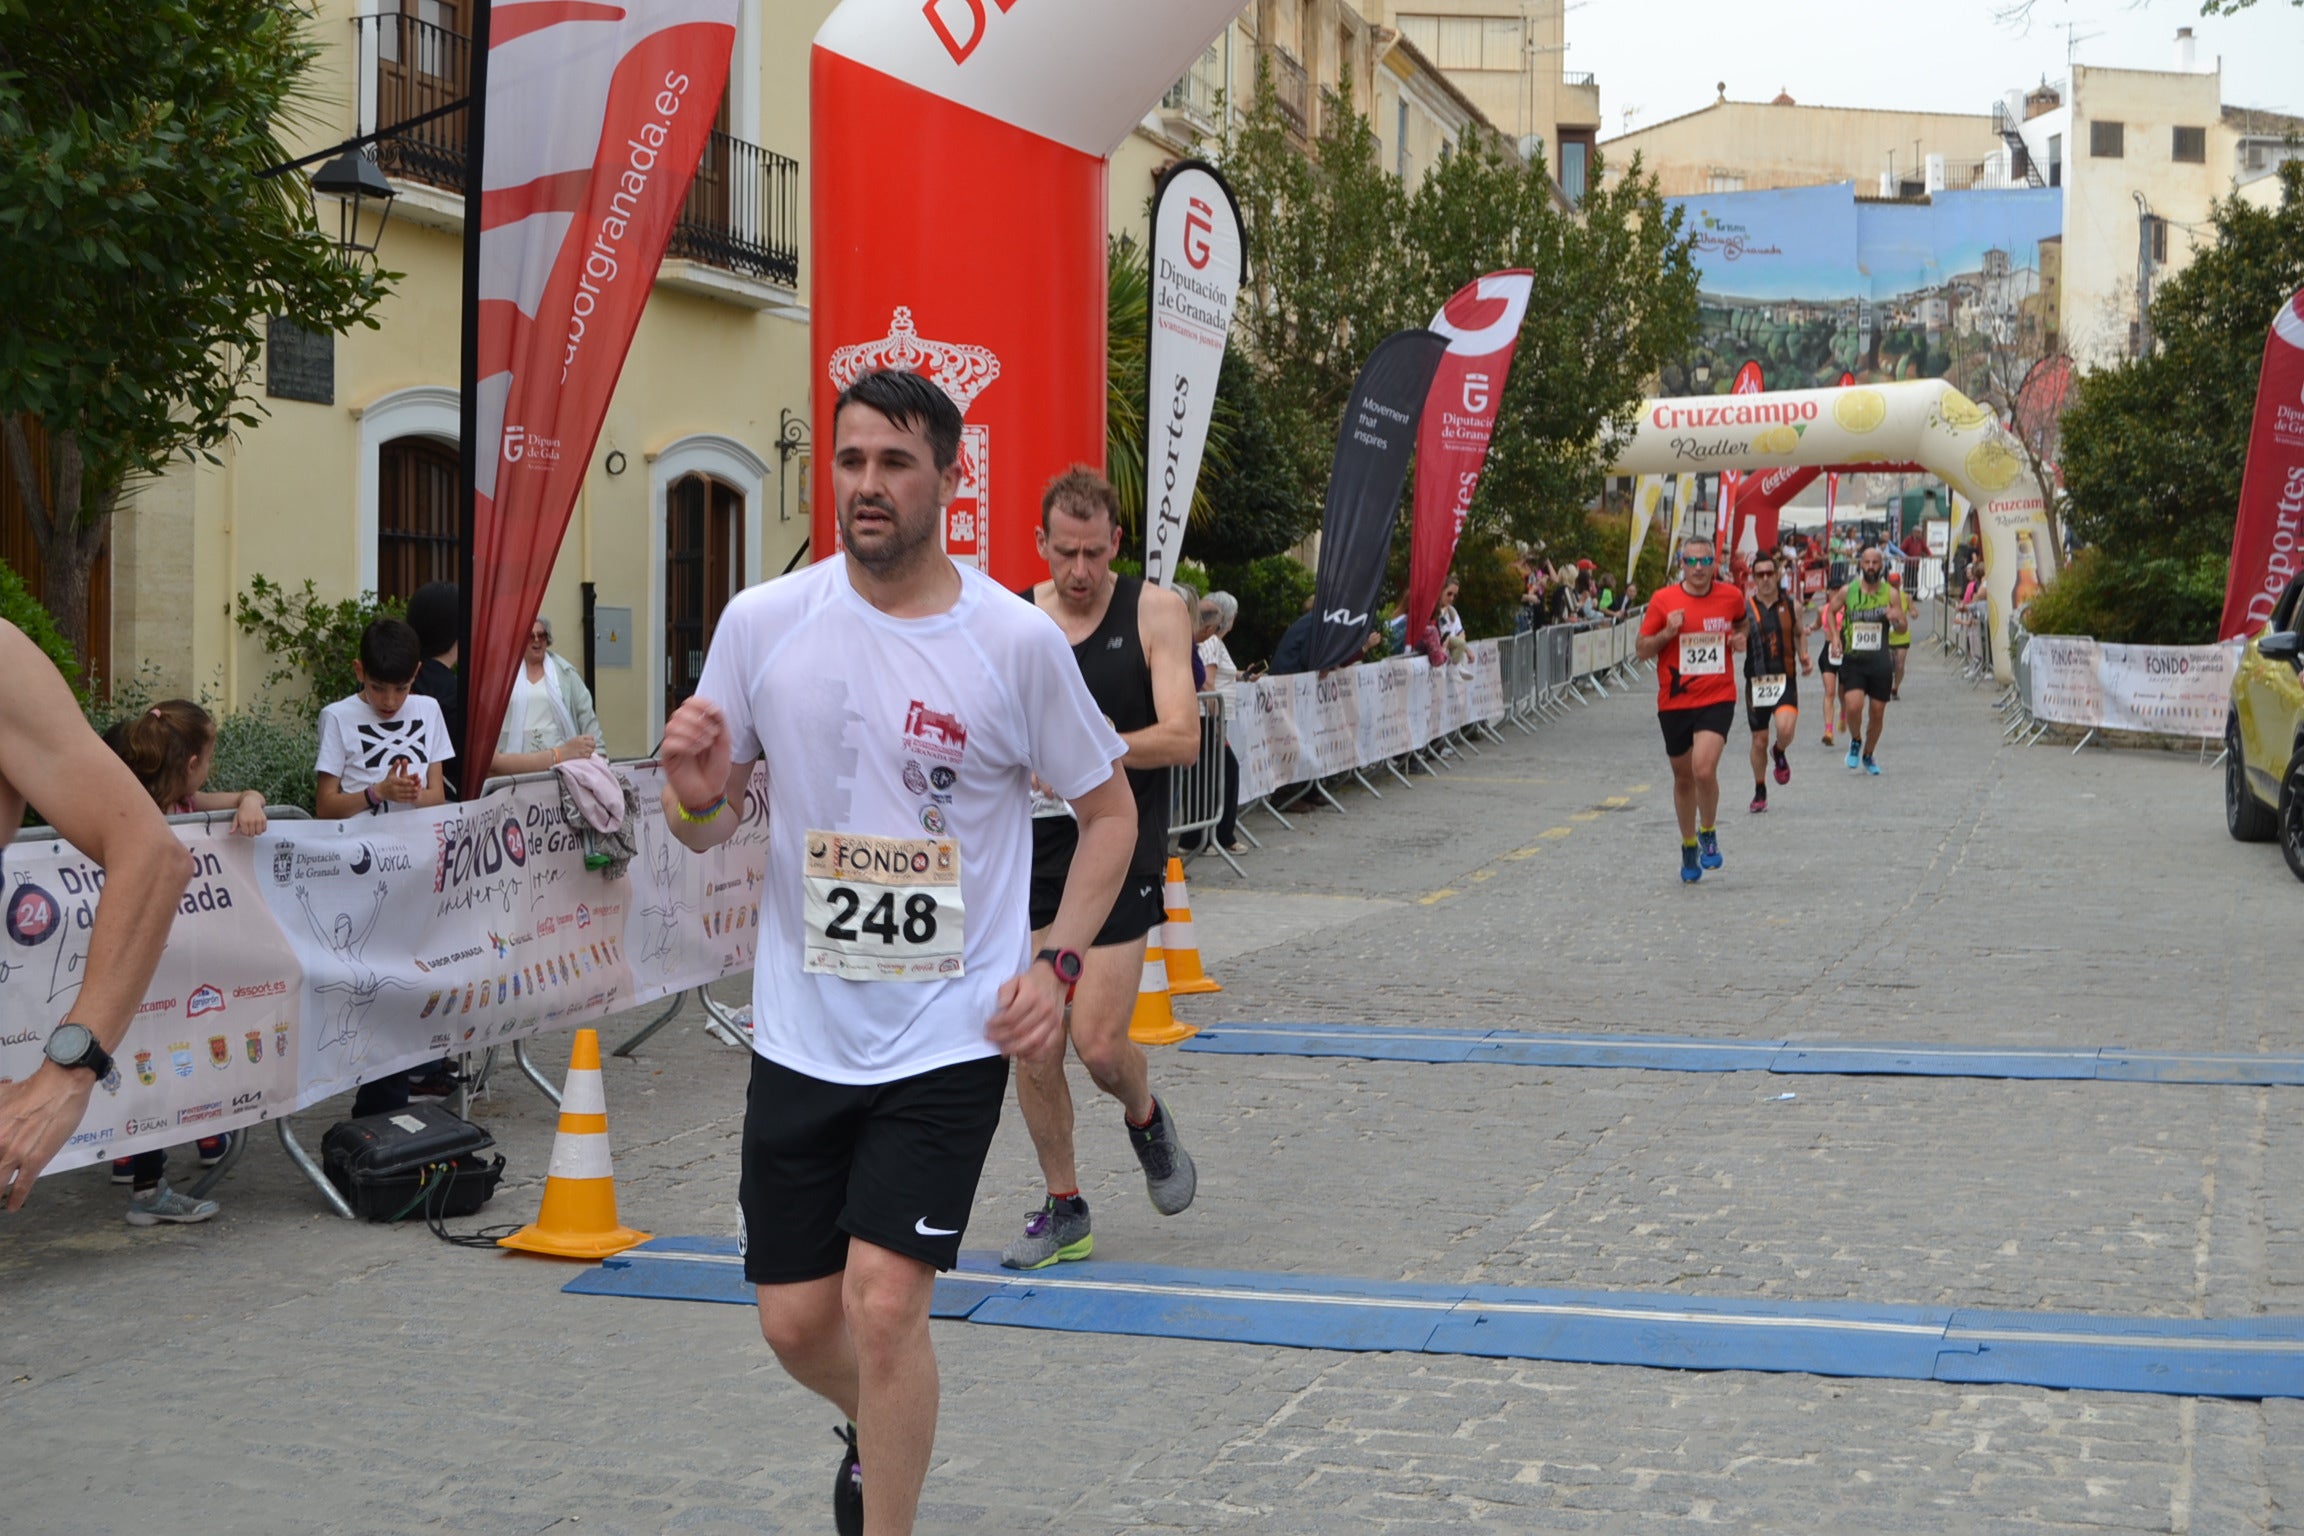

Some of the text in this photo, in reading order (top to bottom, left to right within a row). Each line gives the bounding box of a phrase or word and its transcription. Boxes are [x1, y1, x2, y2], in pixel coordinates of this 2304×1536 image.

[1159, 257, 1227, 307] Diputación
[1158, 285, 1227, 331] de Granada
[1358, 413, 1378, 429] that
[1362, 396, 1410, 425] Movement
[1442, 412, 1496, 428] Diputació
[1653, 401, 1818, 429] Cruzcampo
[1441, 427, 1490, 441] de Grana
[2274, 418, 2288, 433] de
[1353, 429, 1388, 450] inspires
[1670, 437, 1748, 461] Radler
[2246, 466, 2304, 623] Deportes
[1857, 632, 1877, 643] 908
[1687, 648, 1718, 664] 324
[2147, 657, 2189, 674] FONDO
[1758, 686, 1780, 698] 232
[443, 814, 477, 843] GRAN
[527, 830, 584, 857] de Gran
[841, 838, 873, 850] GRAN
[875, 842, 915, 853] PREMIO
[296, 851, 341, 865] Diputación
[440, 817, 527, 893] FONDO
[838, 845, 930, 873] FONDO
[295, 866, 340, 879] de Granada
[18, 901, 49, 928] 24
[825, 887, 938, 945] 248
